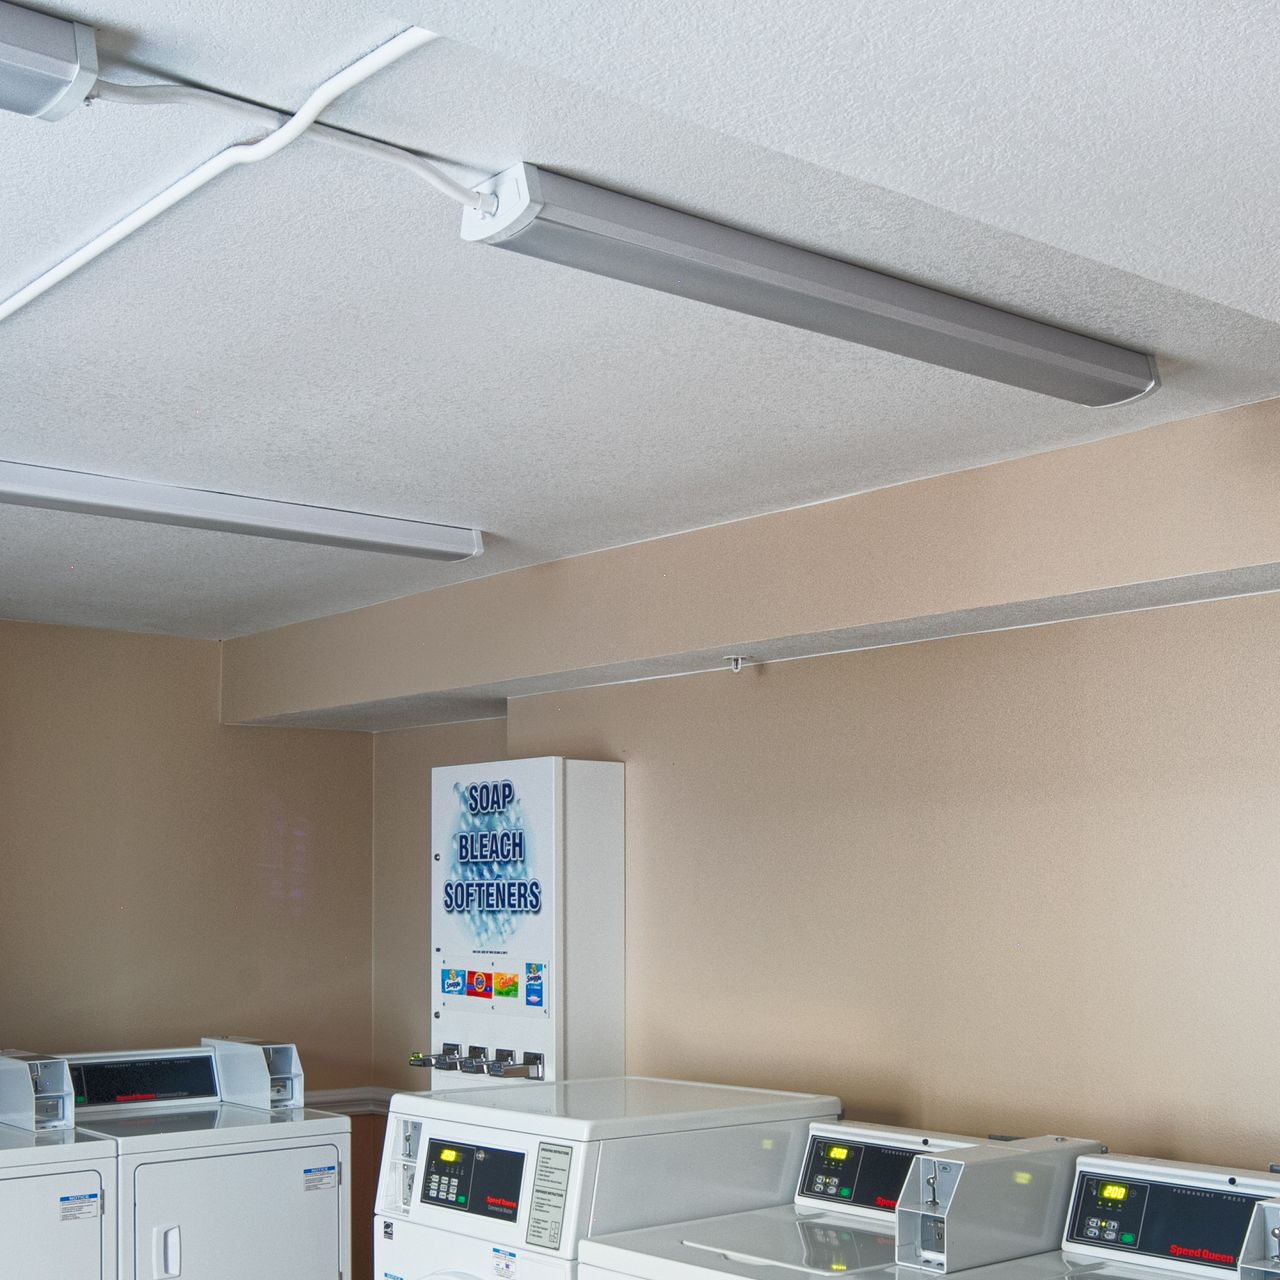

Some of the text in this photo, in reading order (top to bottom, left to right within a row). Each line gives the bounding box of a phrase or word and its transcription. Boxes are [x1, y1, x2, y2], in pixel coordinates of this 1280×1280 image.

[468, 781, 514, 812] SOAP
[458, 831, 524, 862] BLEACH
[443, 880, 542, 912] SOFTENERS
[1103, 1185, 1126, 1199] 200
[1170, 1244, 1234, 1263] Speed Queen
